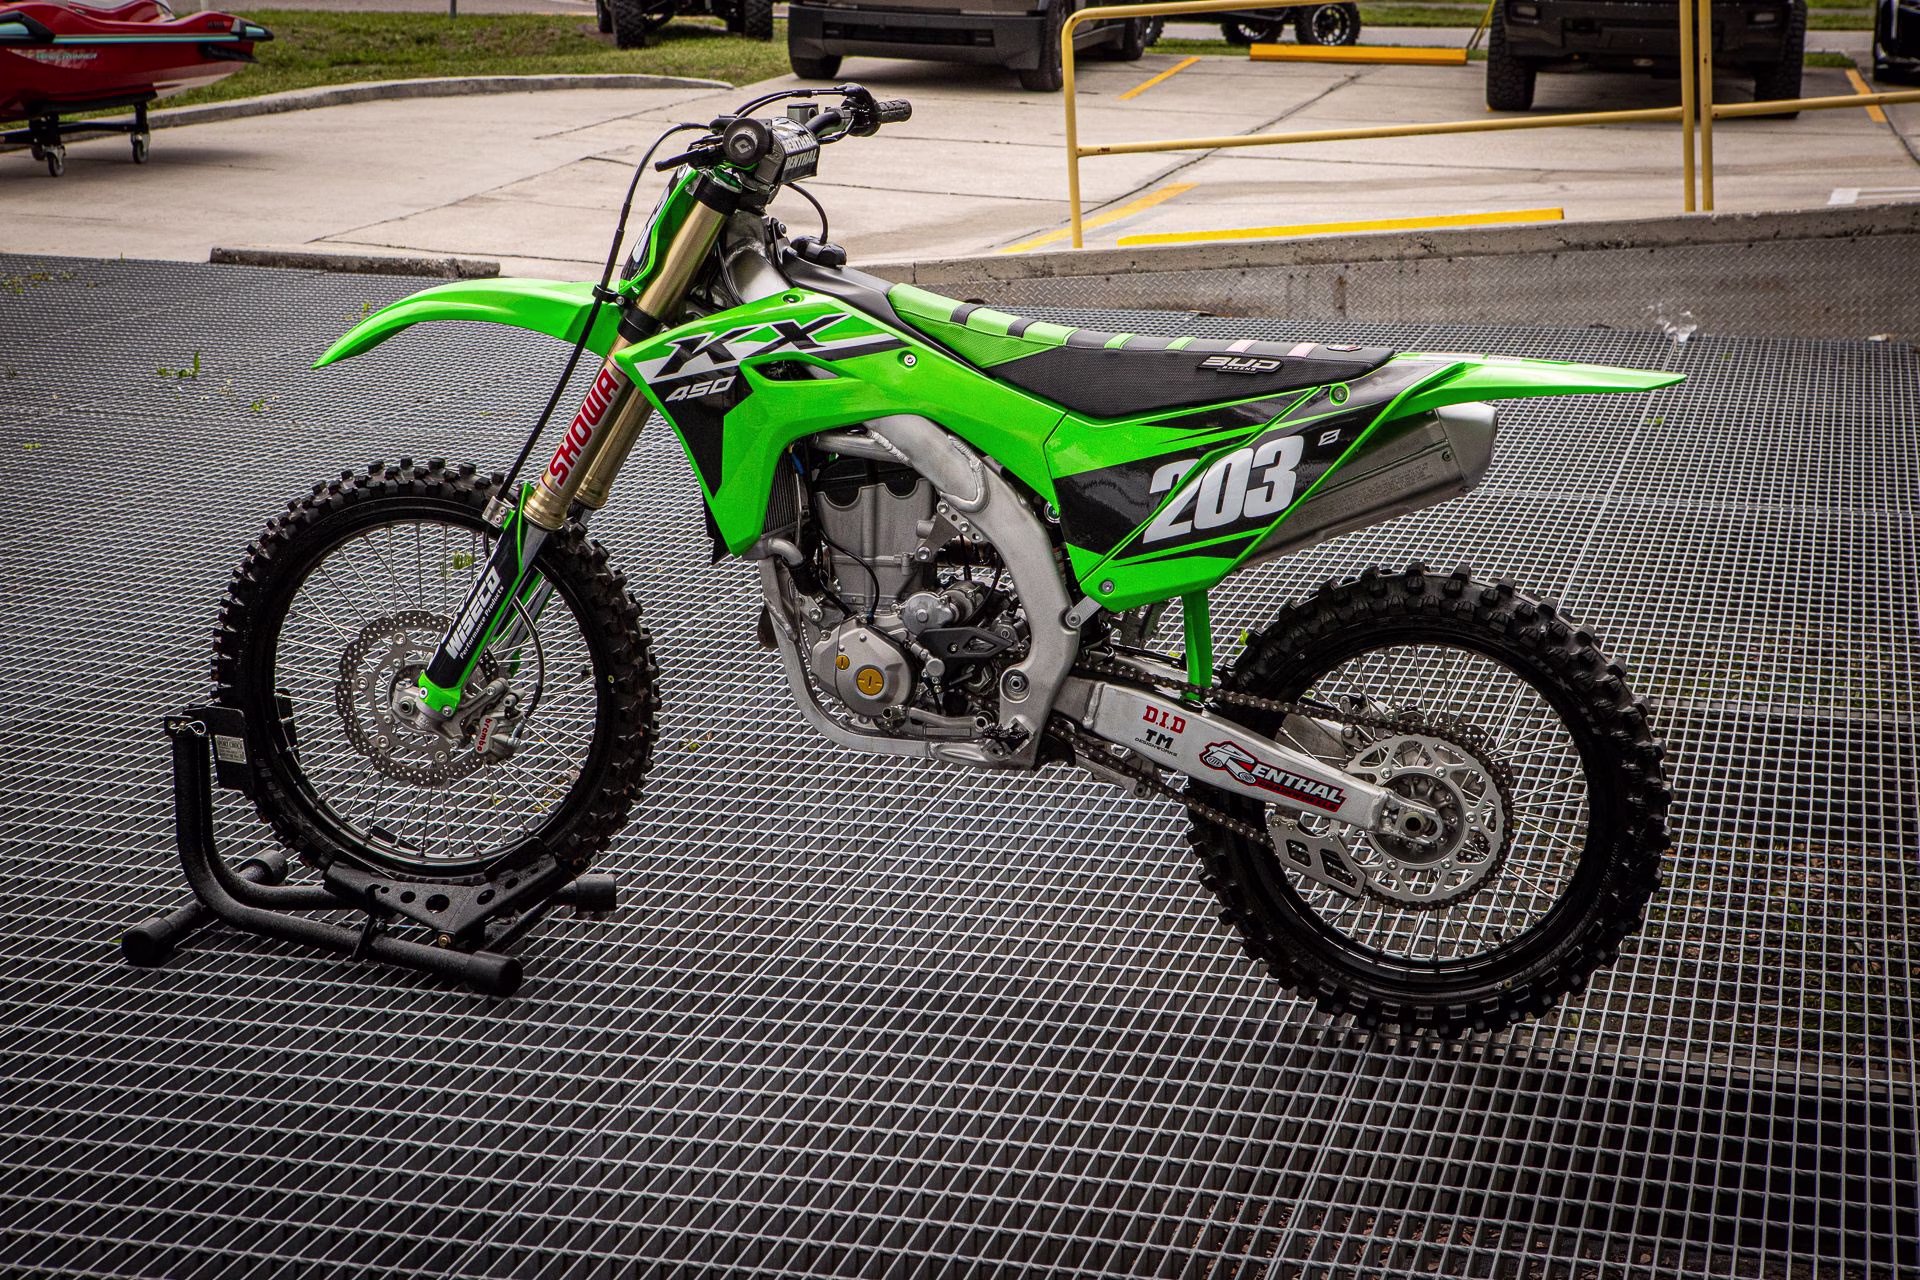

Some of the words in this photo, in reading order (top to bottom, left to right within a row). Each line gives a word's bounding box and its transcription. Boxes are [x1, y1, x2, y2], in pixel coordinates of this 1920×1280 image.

[783, 148, 818, 169] RENTHAL
[654, 313, 852, 379] KX
[1202, 355, 1282, 370] BUD
[665, 375, 737, 402] 450
[549, 368, 619, 487] SHOWA
[1142, 435, 1304, 544] 203
[460, 616, 486, 660] Performance
[484, 585, 504, 617] Products
[1142, 705, 1187, 734] D.I.D
[476, 718, 493, 752] brembo
[1134, 736, 1178, 758] DESIGNWORKS
[1146, 728, 1174, 749] TM
